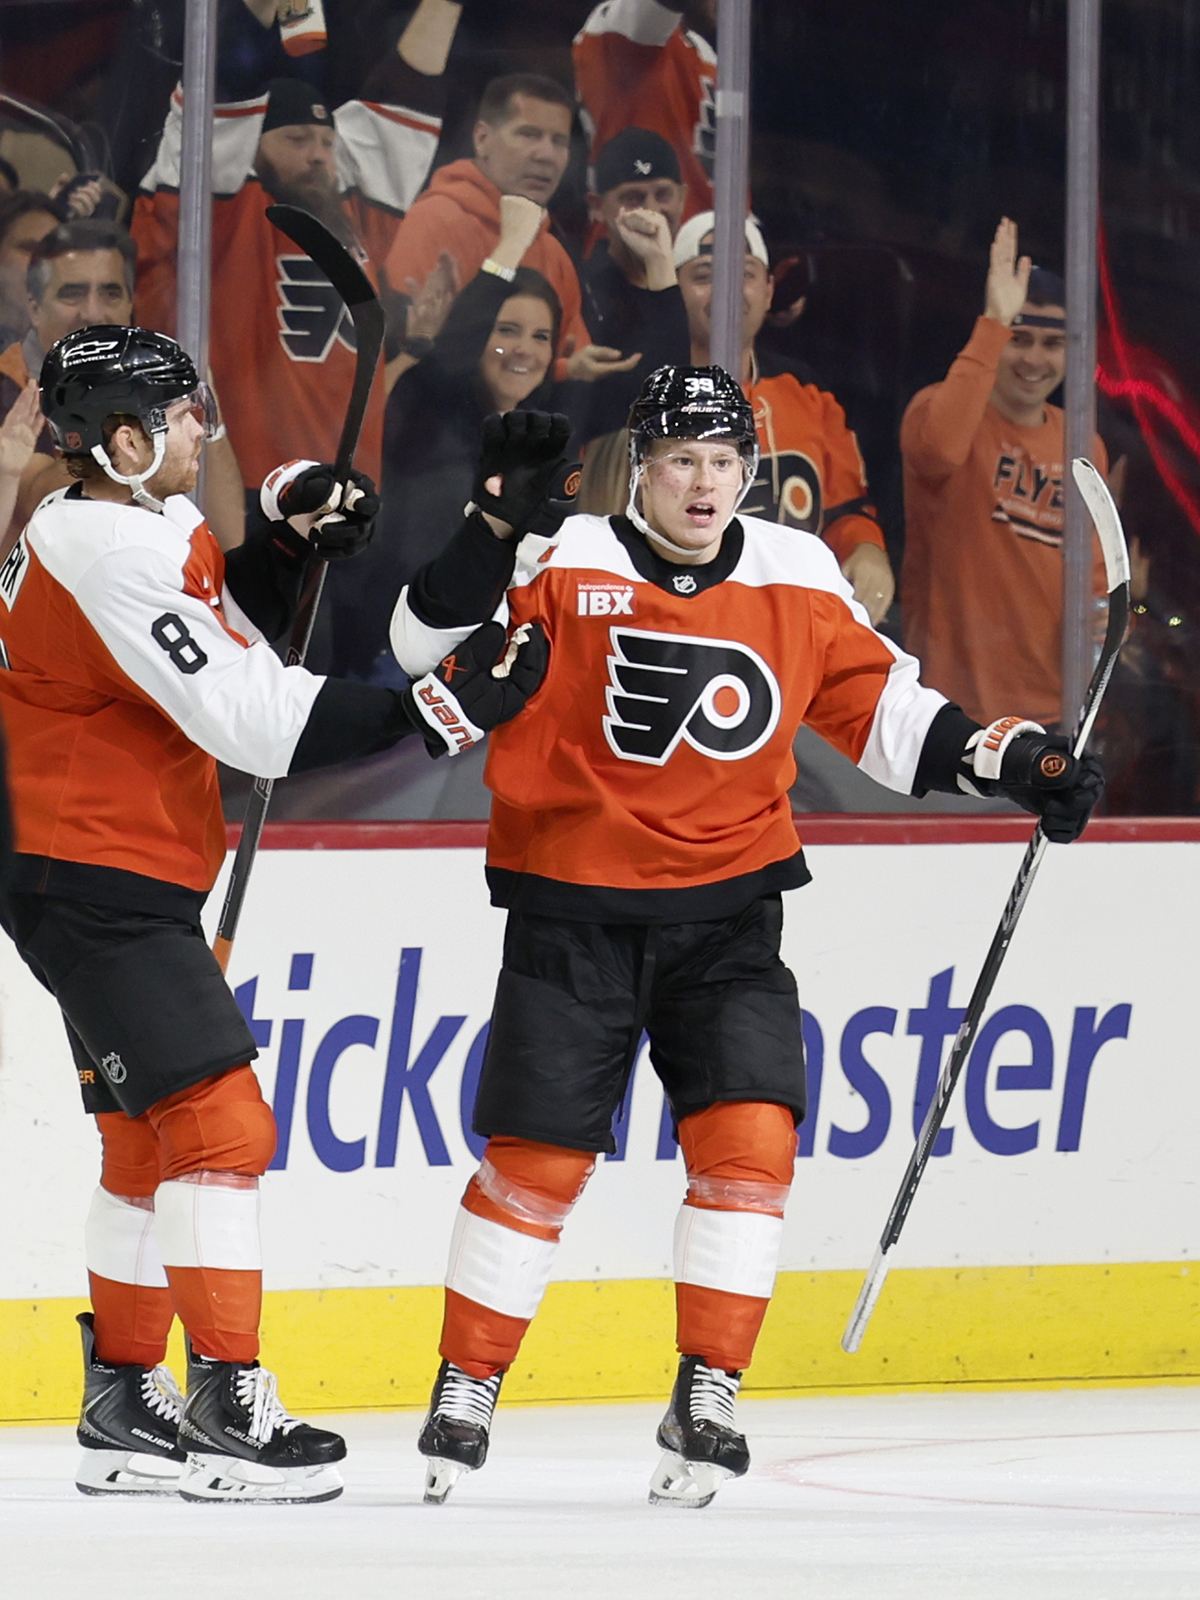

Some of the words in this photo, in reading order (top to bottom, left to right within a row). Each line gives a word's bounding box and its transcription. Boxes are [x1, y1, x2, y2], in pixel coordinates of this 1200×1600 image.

[684, 377, 715, 392] 39
[577, 591, 634, 615] IBX
[151, 612, 208, 674] 8
[131, 1427, 174, 1450] BAUER
[224, 1426, 264, 1450] BAUER
